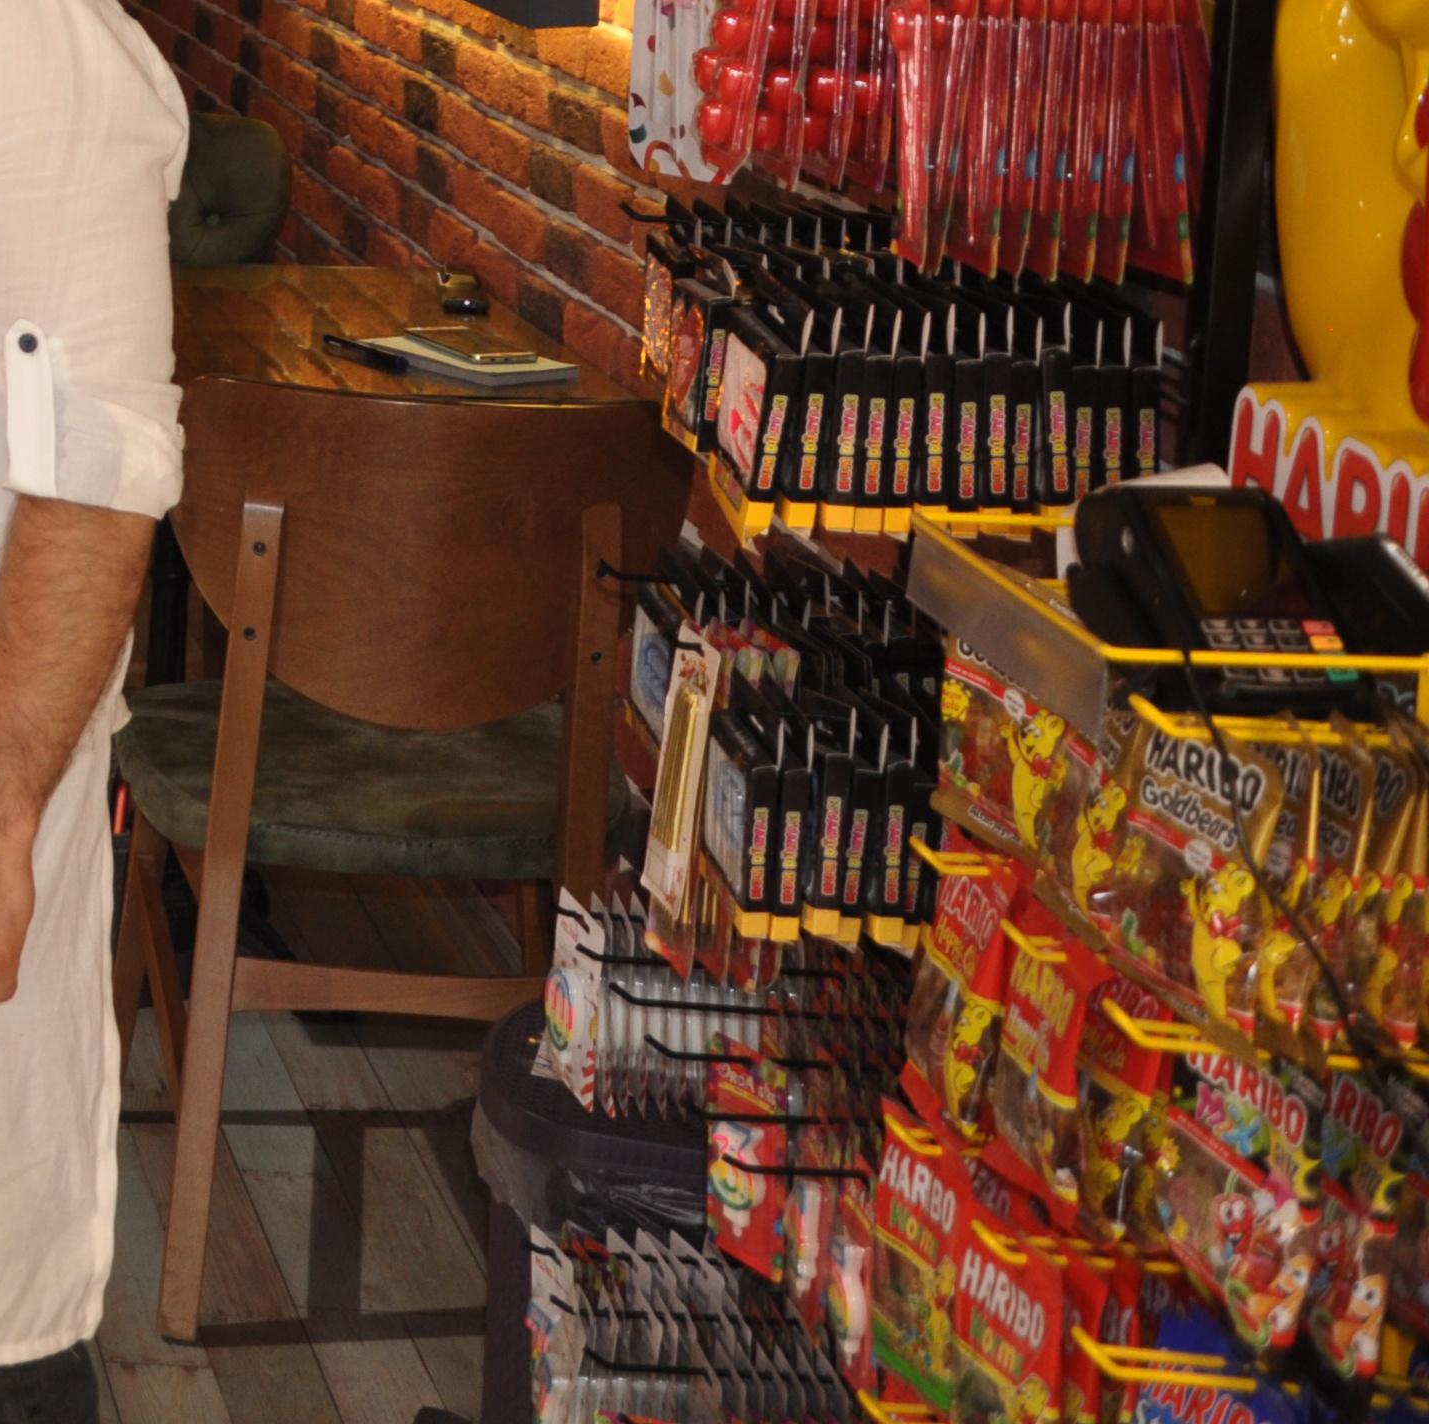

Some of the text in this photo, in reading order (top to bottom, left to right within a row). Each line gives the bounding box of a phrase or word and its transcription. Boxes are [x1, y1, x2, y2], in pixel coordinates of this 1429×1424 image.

[1228, 391, 1429, 574] HARI
[1141, 773, 1239, 850] Goldbears
[959, 1246, 1046, 1351] HARIBO
